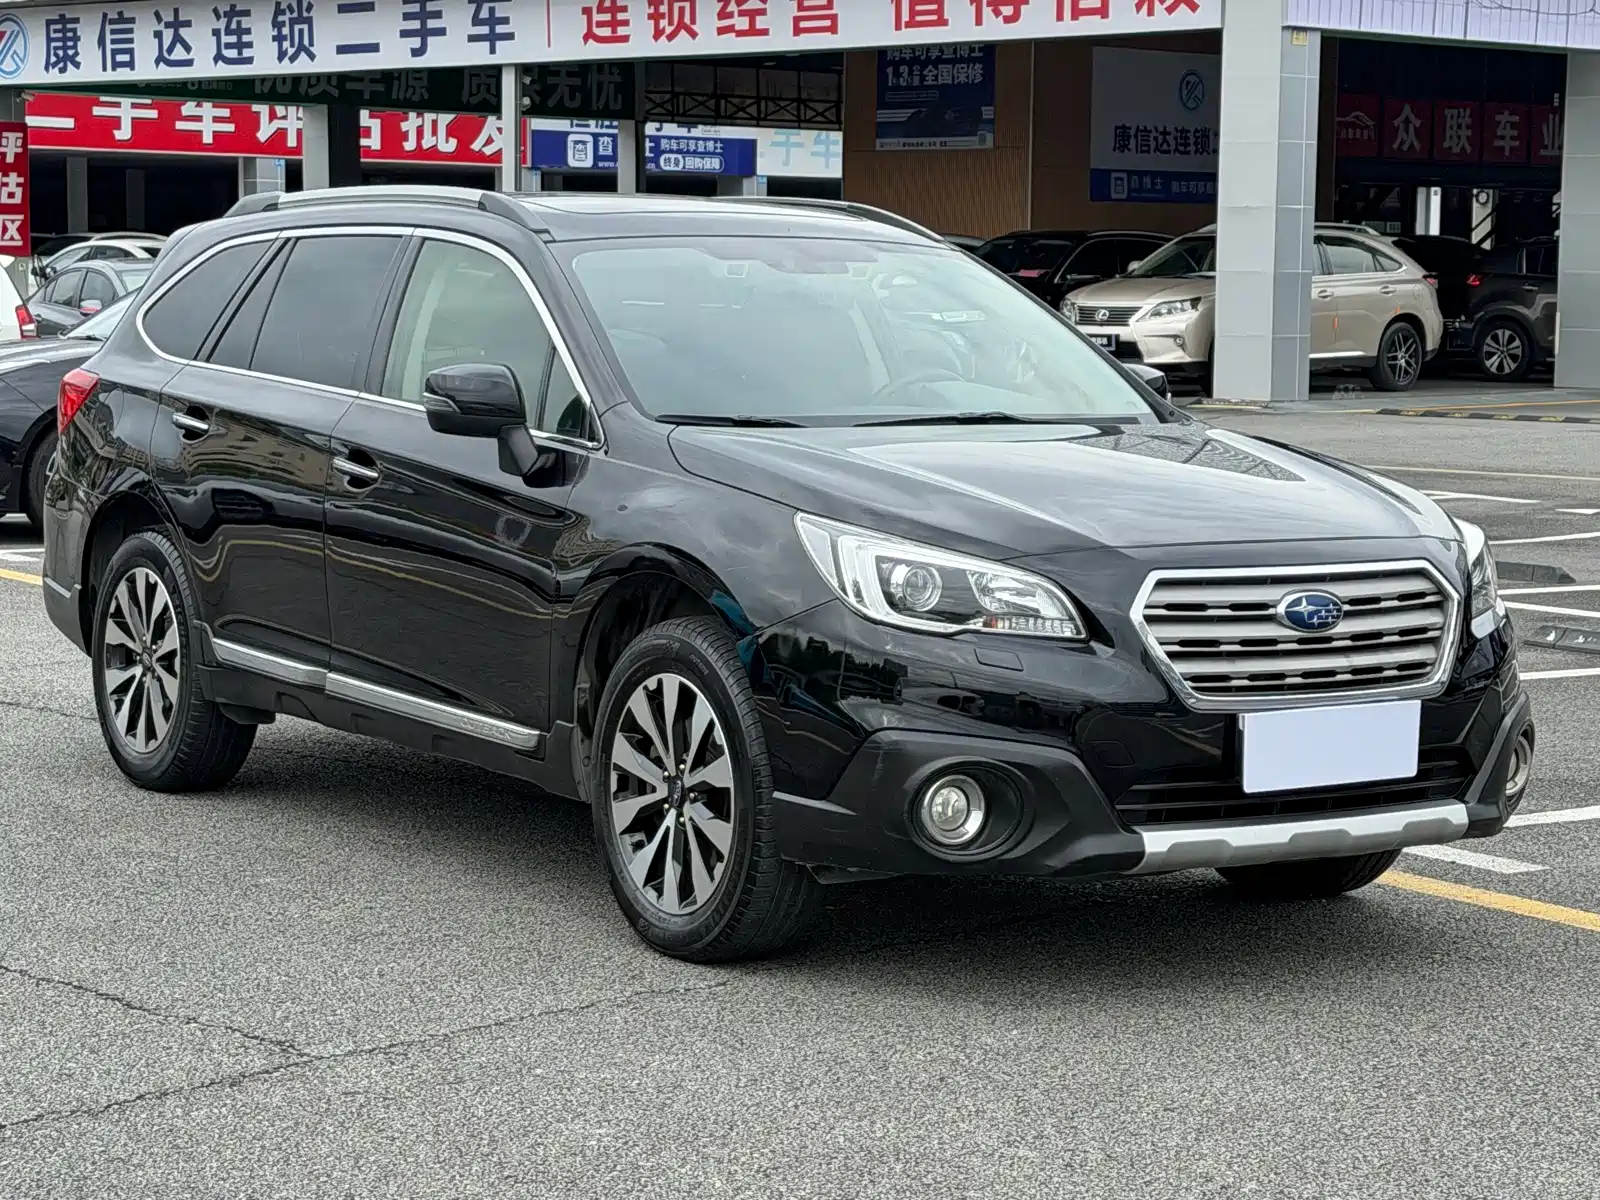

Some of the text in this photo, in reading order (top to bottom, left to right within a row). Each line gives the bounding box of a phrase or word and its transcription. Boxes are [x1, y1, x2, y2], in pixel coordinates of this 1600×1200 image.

[43, 0, 516, 75] 康信达连锁二手车
[661, 138, 724, 153] 购车可享查博士
[1112, 124, 1218, 155] 康信达连锁
[1391, 102, 1561, 156] 众联车业
